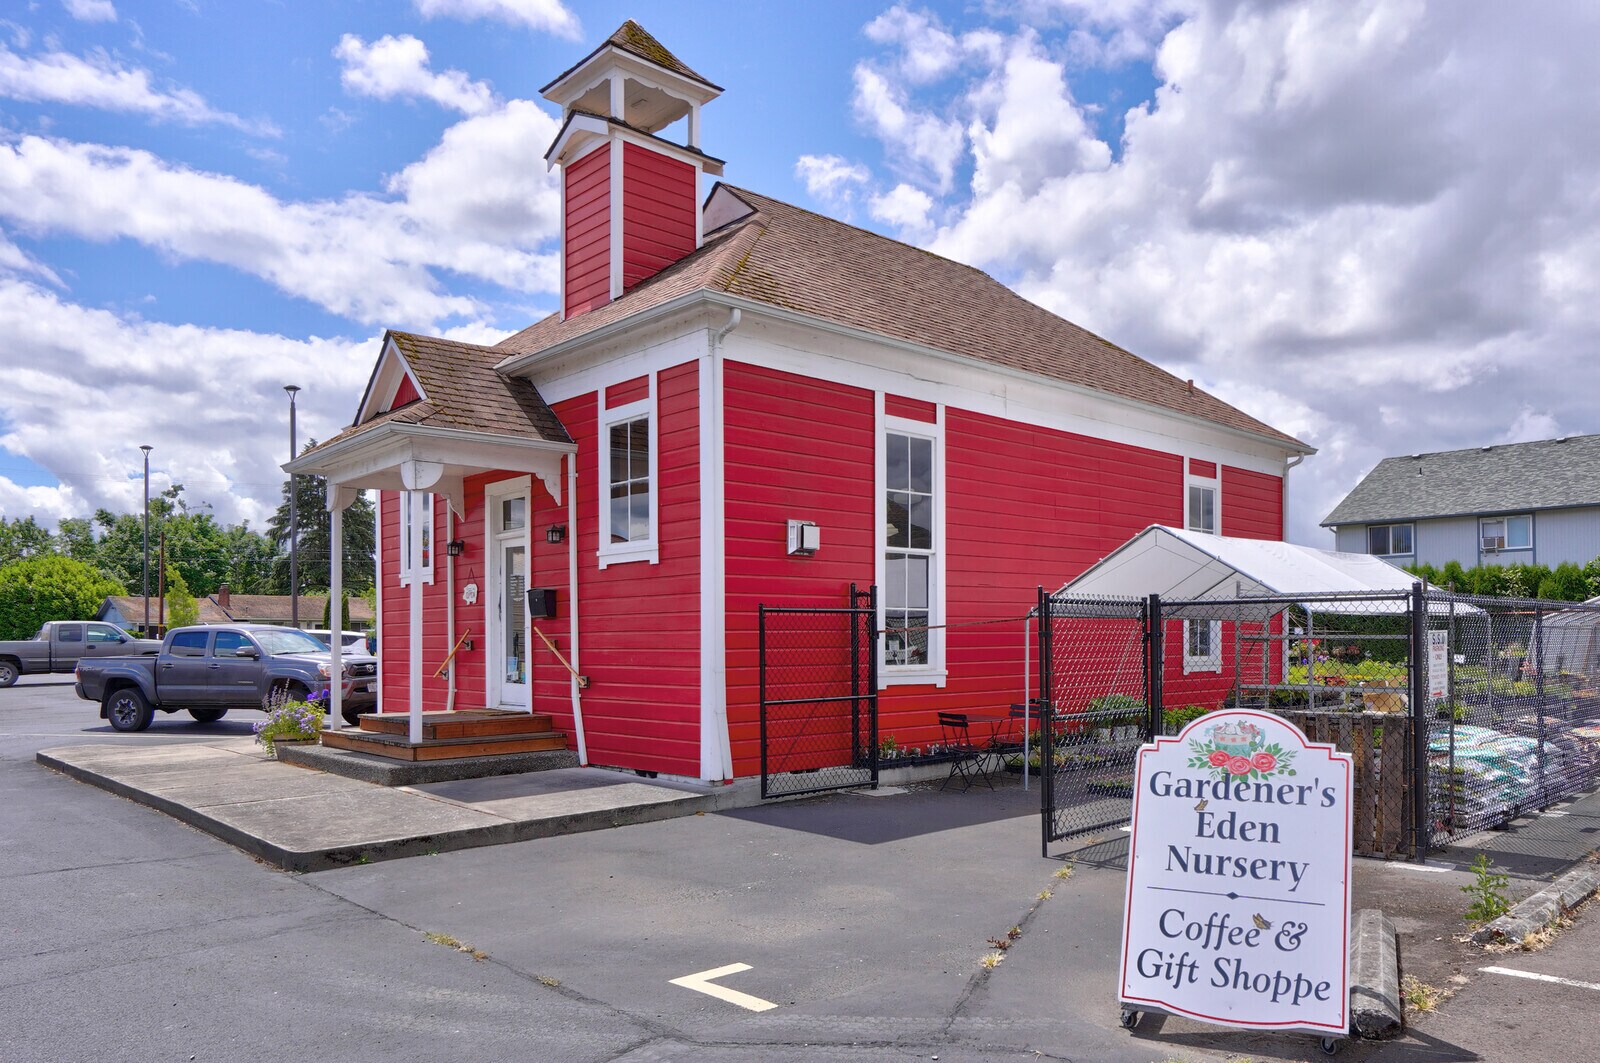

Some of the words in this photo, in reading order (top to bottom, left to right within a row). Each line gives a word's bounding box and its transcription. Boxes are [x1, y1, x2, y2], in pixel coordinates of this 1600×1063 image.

[1149, 770, 1336, 808] Gardener's
[1195, 811, 1281, 844] Eden
[1165, 844, 1310, 892] Nursery
[1158, 908, 1261, 951] Coffee
[1274, 920, 1308, 952] &
[1136, 948, 1200, 990] Gift
[1210, 957, 1331, 1006] Shoppe
